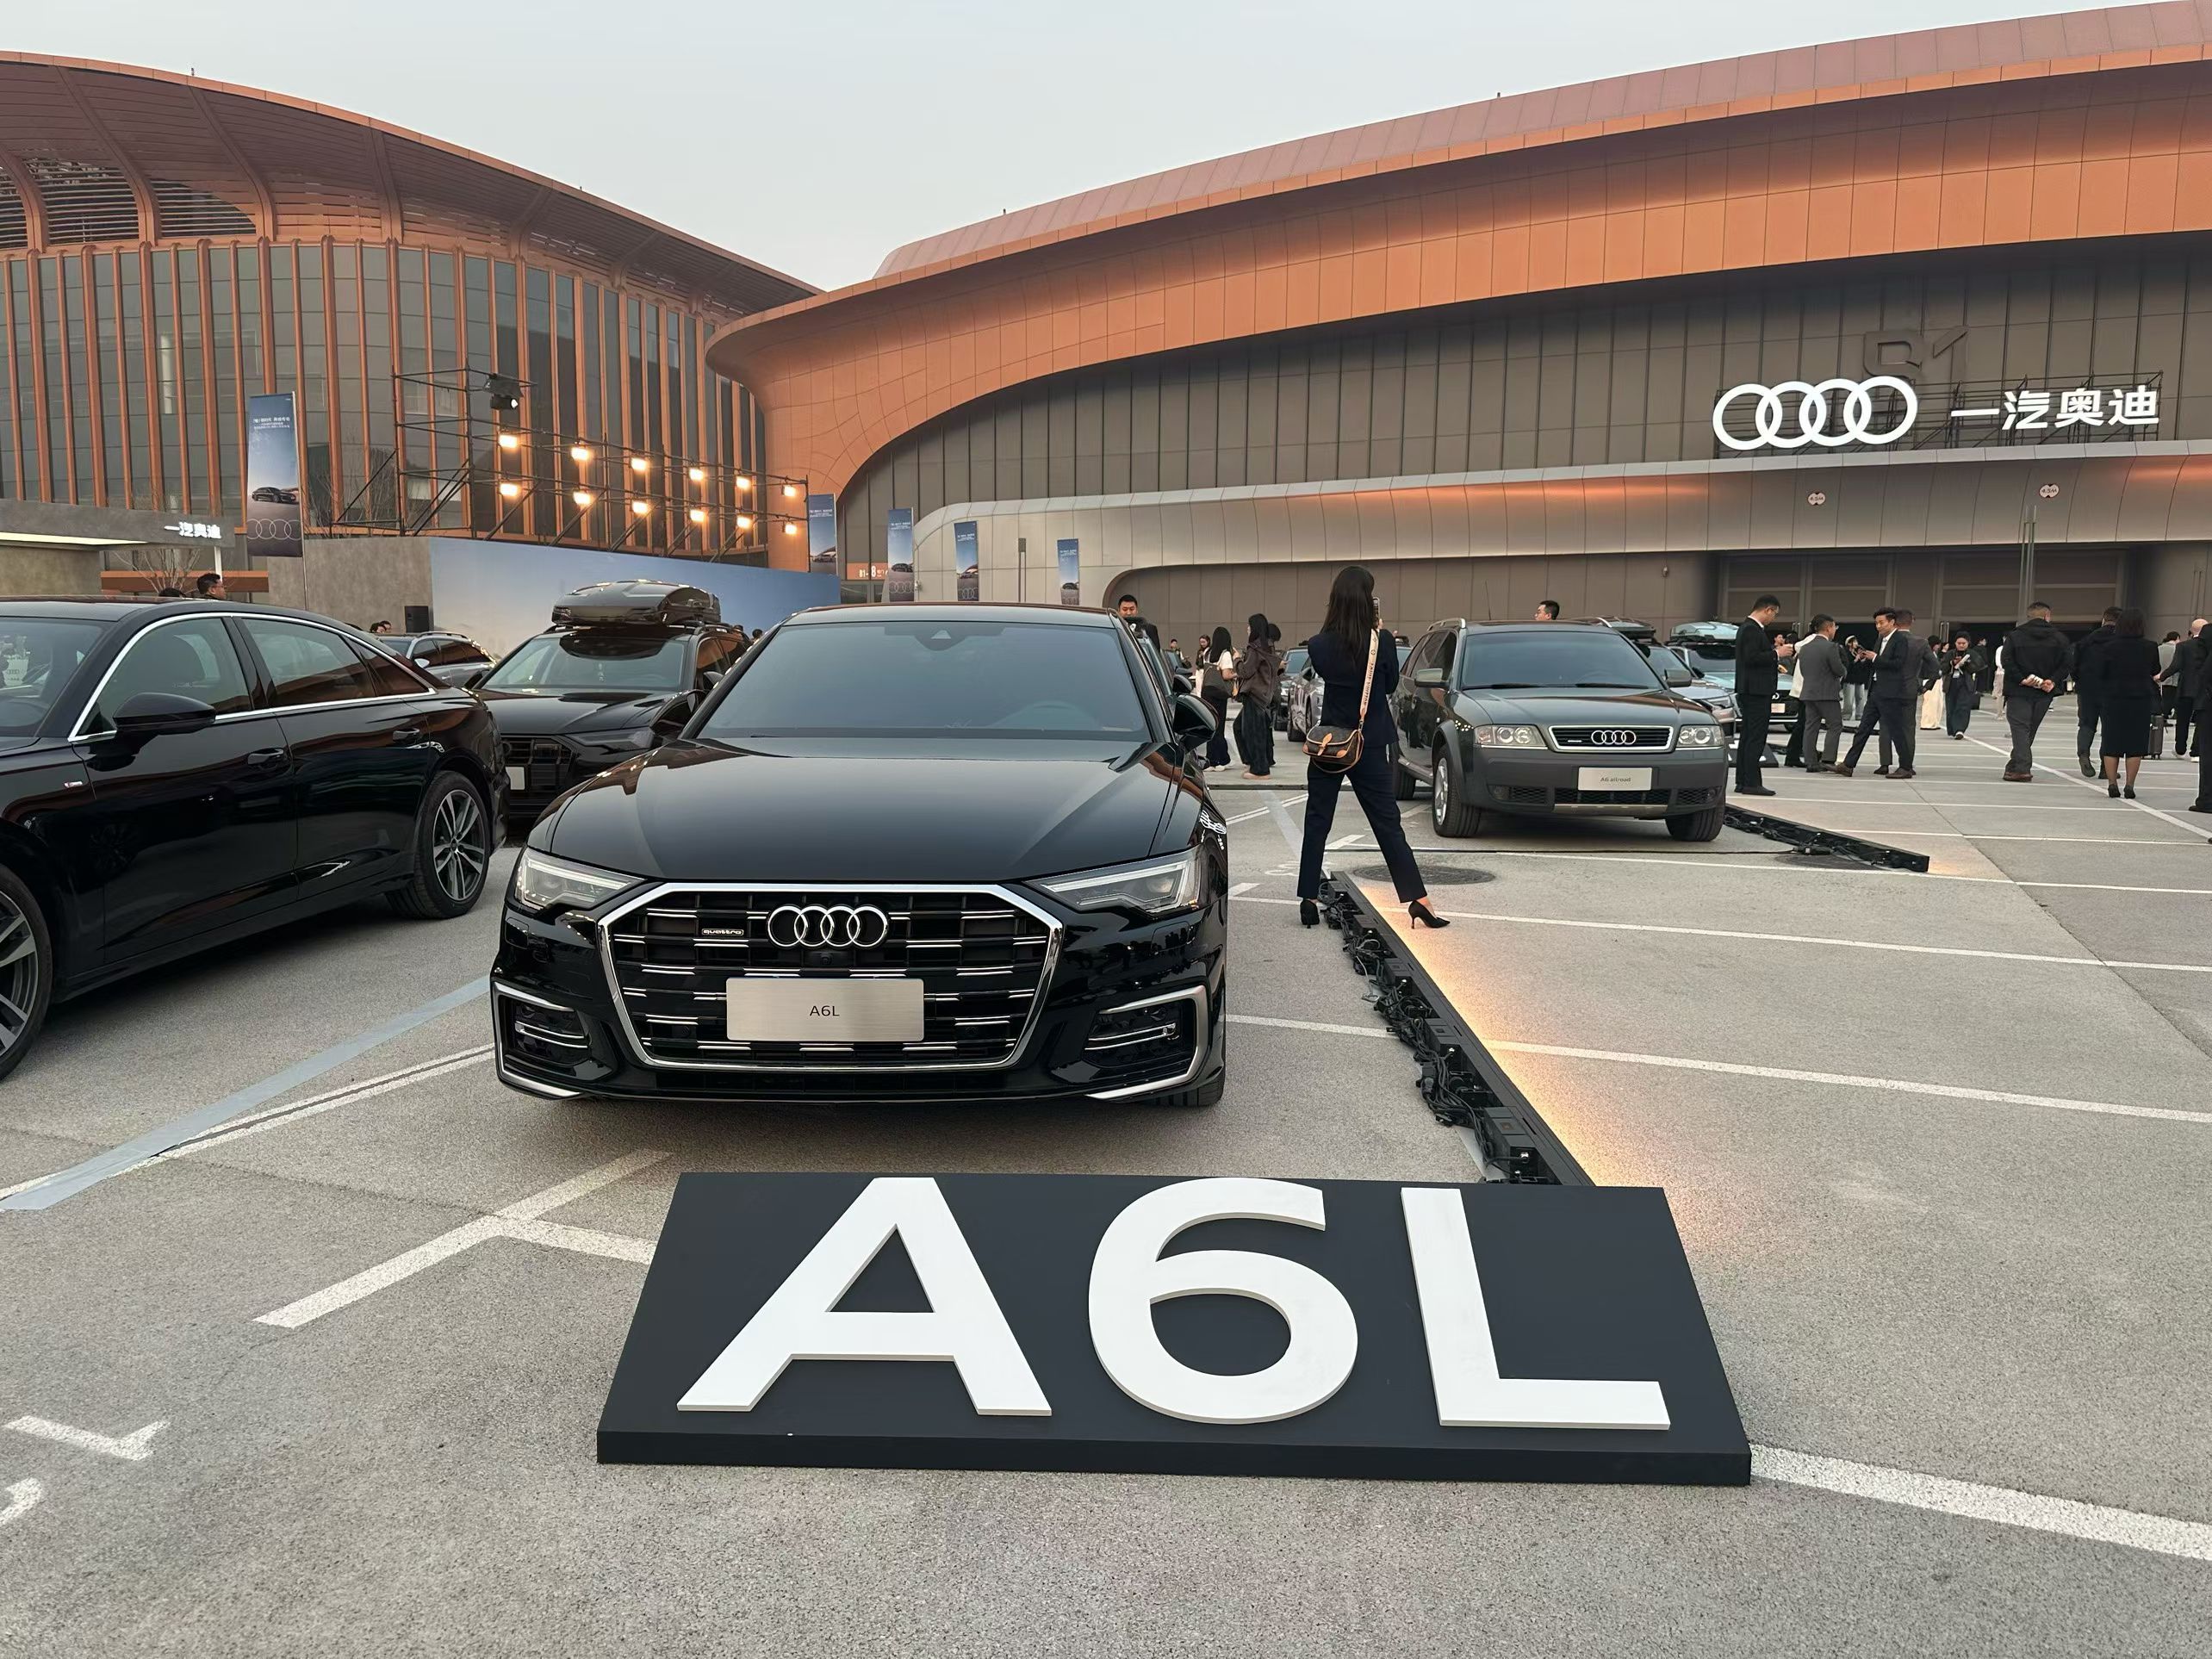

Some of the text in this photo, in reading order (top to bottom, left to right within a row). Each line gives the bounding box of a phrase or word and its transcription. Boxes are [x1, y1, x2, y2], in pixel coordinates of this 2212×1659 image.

[1950, 384, 2160, 431] 一汽奥迪
[809, 1004, 841, 1017] A6L
[677, 1176, 1671, 1431] A6L
